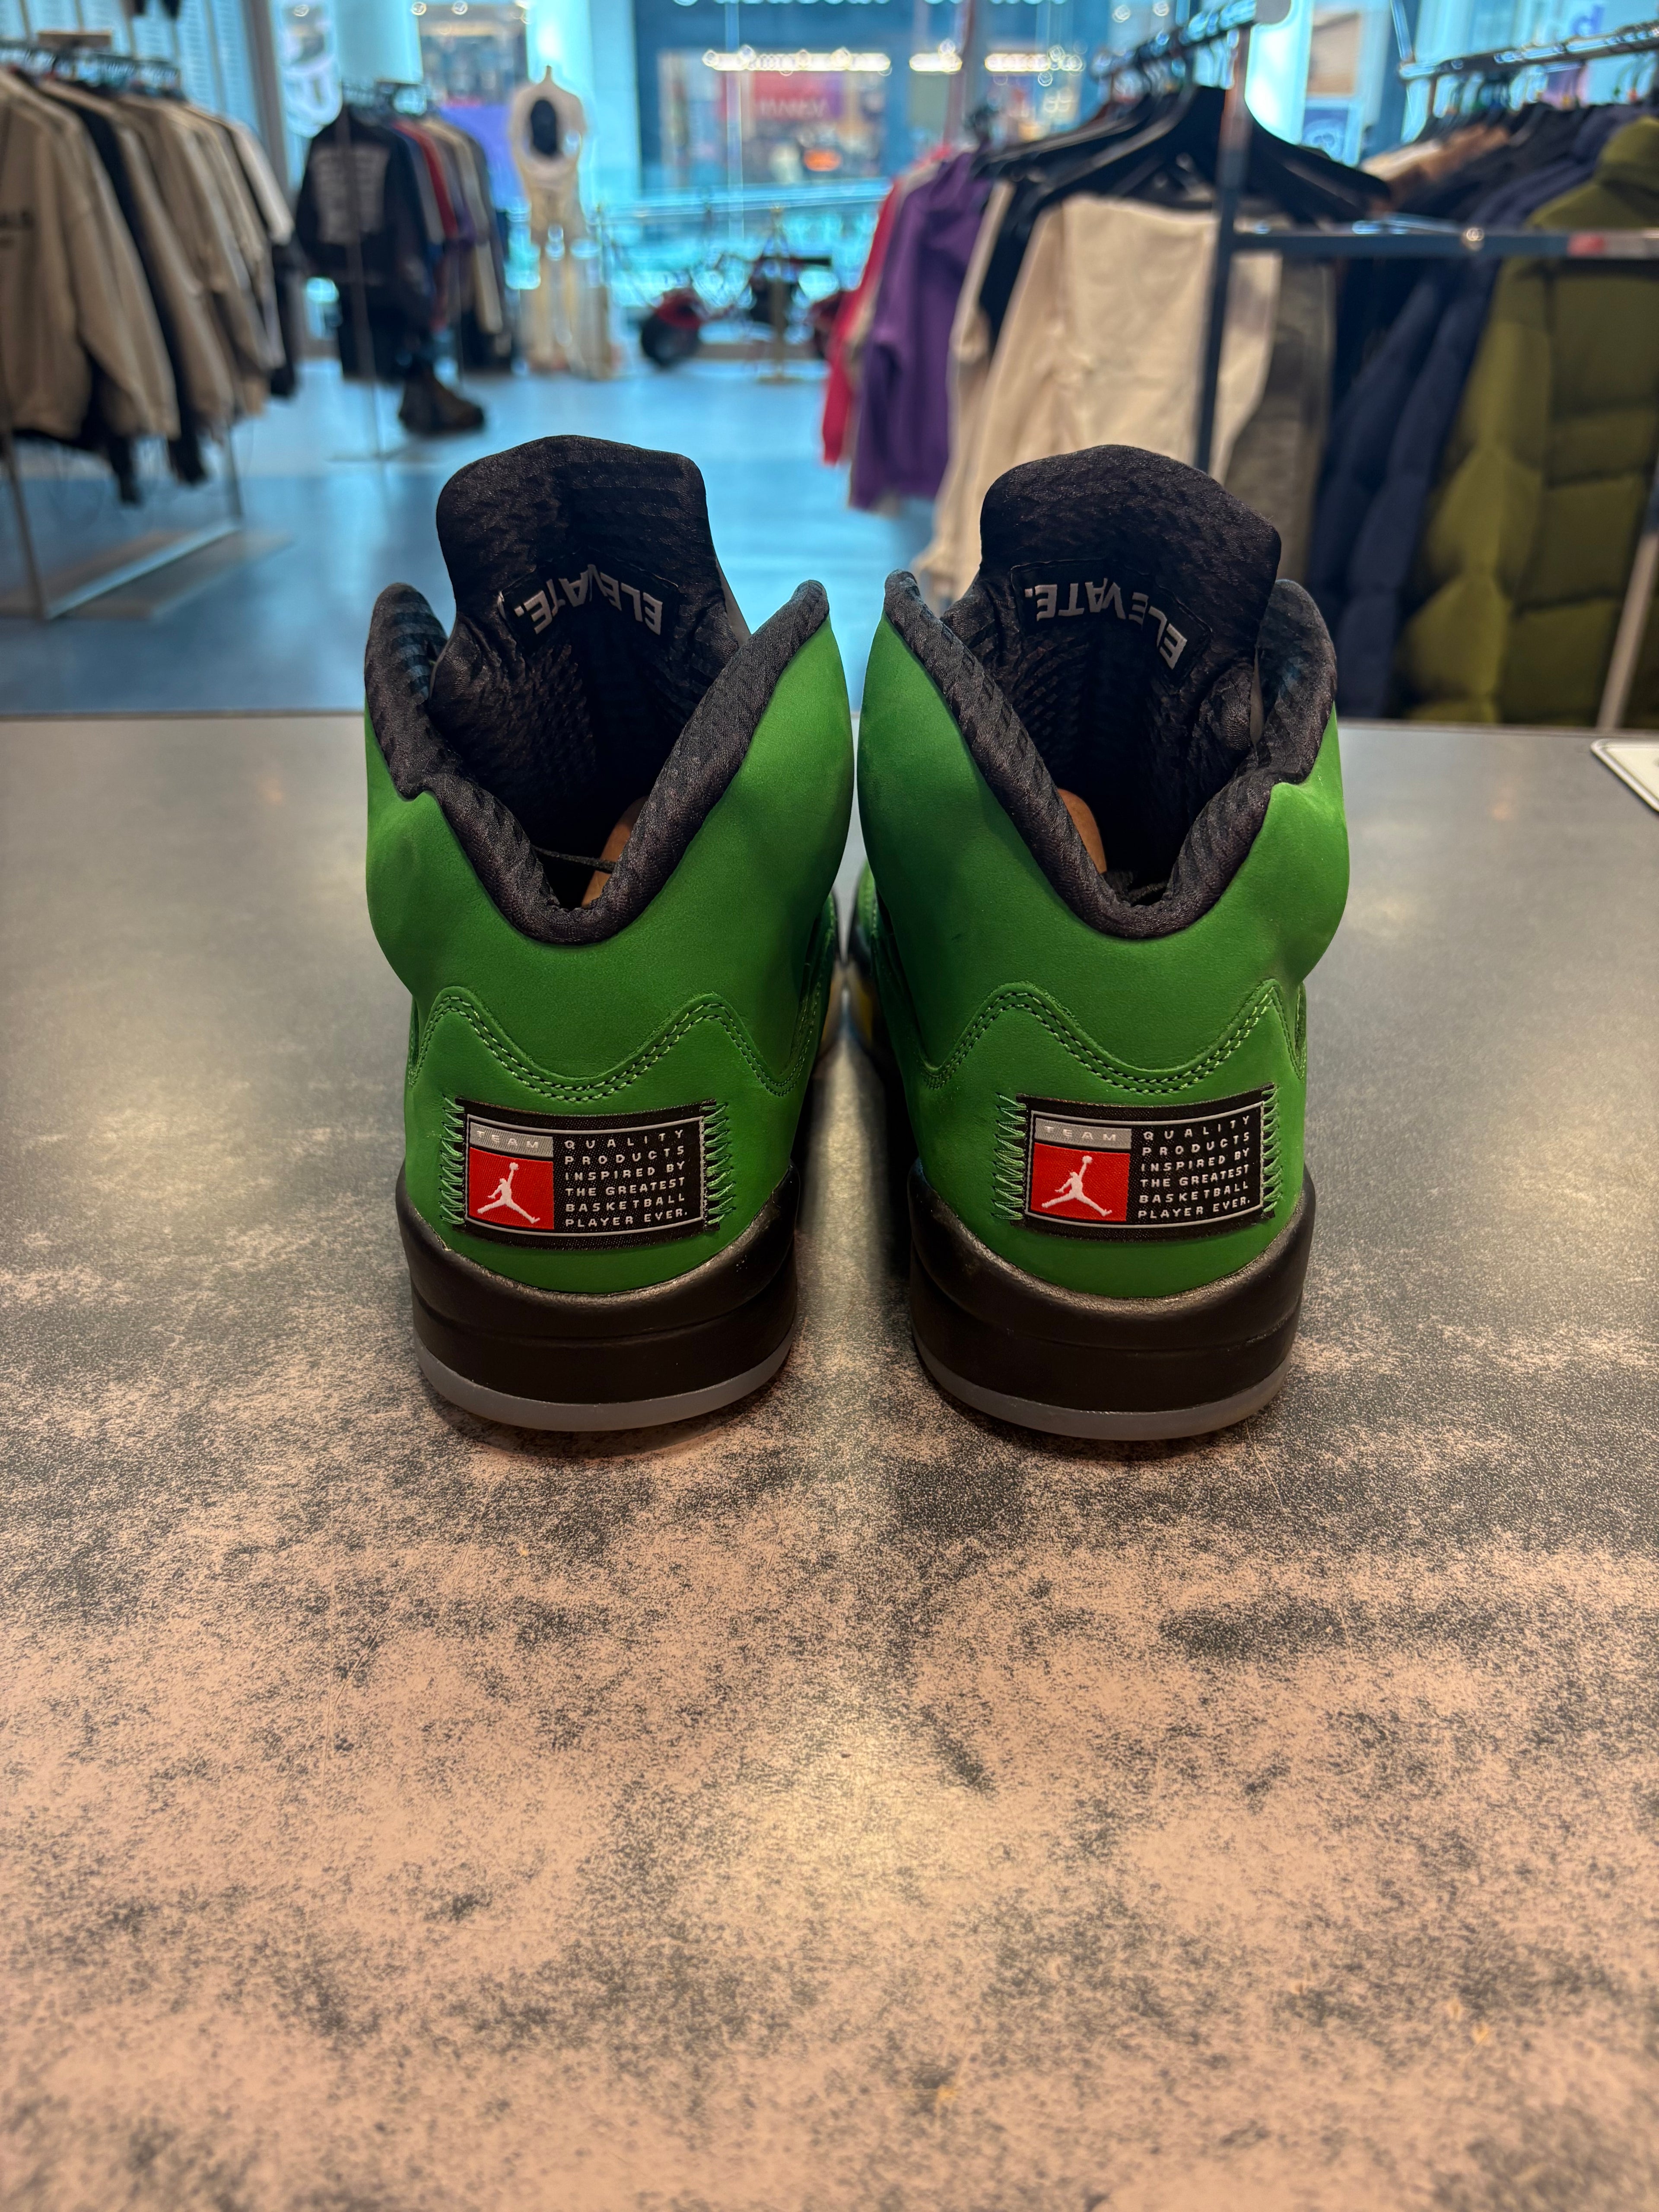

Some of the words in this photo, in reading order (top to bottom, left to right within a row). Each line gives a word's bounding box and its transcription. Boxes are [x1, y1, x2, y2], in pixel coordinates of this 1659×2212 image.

[1025, 578, 1187, 670] ELEVATE.
[1044, 1125, 1117, 1141] TEAM
[1143, 1115, 1249, 1140] QUALITY
[477, 1131, 539, 1148] TEAM
[564, 1129, 683, 1149] QUALITY
[1142, 1132, 1250, 1156] PRODUCTS
[565, 1146, 684, 1165] PRODUCTS
[1141, 1155, 1225, 1171] INSPIRED
[1234, 1148, 1249, 1160] BY
[565, 1167, 655, 1181] INSPIRED
[667, 1161, 685, 1173] BY
[1140, 1178, 1170, 1188] THE
[1179, 1164, 1249, 1186] GREATEST
[565, 1188, 596, 1196] THE
[606, 1177, 685, 1195] GREATEST
[1139, 1181, 1249, 1204] BASKETBALL
[566, 1193, 685, 1212] BASKETBALL
[1138, 1206, 1203, 1219] PLAYER
[1213, 1198, 1250, 1212] EVER.
[566, 1216, 633, 1227] PLAYER
[644, 1208, 687, 1222] EVER.
